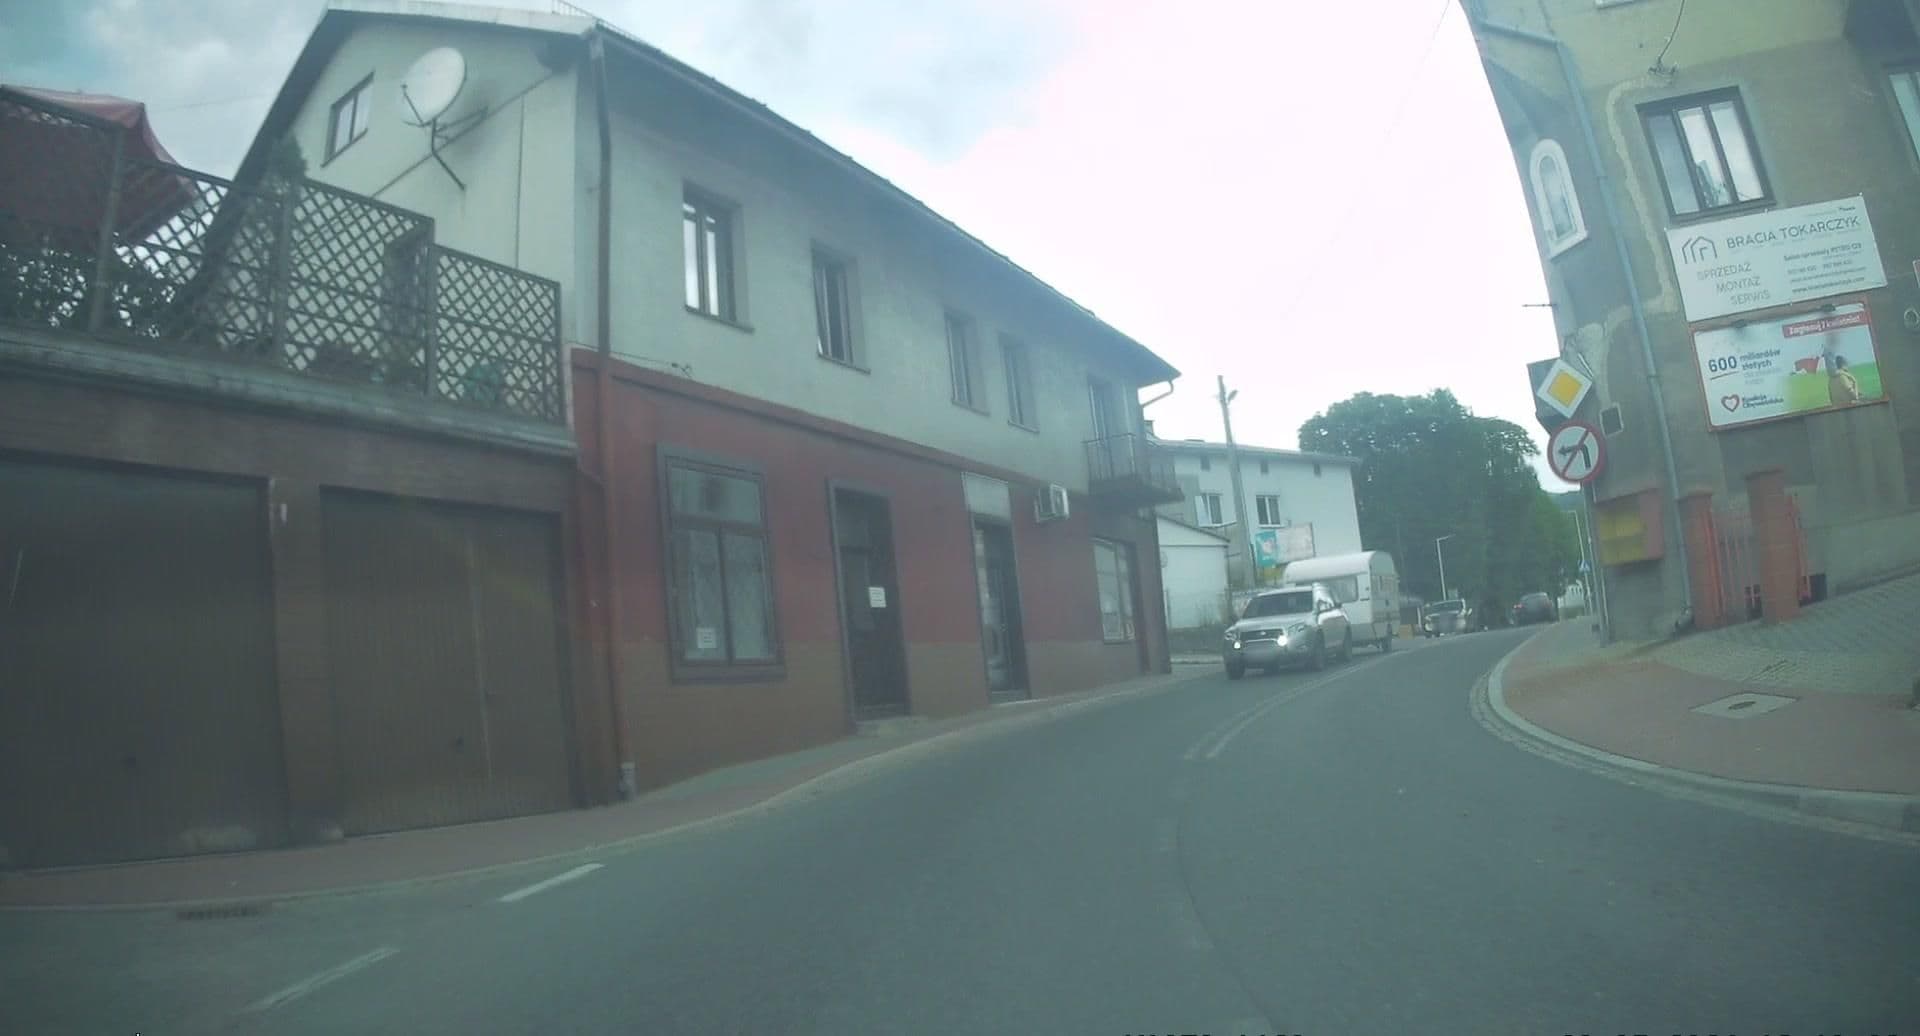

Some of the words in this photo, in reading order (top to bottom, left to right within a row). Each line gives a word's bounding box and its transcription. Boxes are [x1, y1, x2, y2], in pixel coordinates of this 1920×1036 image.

[1726, 231, 1777, 249] BRACIA
[1780, 215, 1860, 239] TOKARCZYK
[1696, 261, 1752, 281] SPRZEDAŻ
[1716, 275, 1761, 294] MONTAŻ
[1730, 290, 1771, 306] SERWIS
[1708, 356, 1737, 372] 600
[1739, 348, 1781, 361] miliardów
[1742, 359, 1772, 371] złotych
